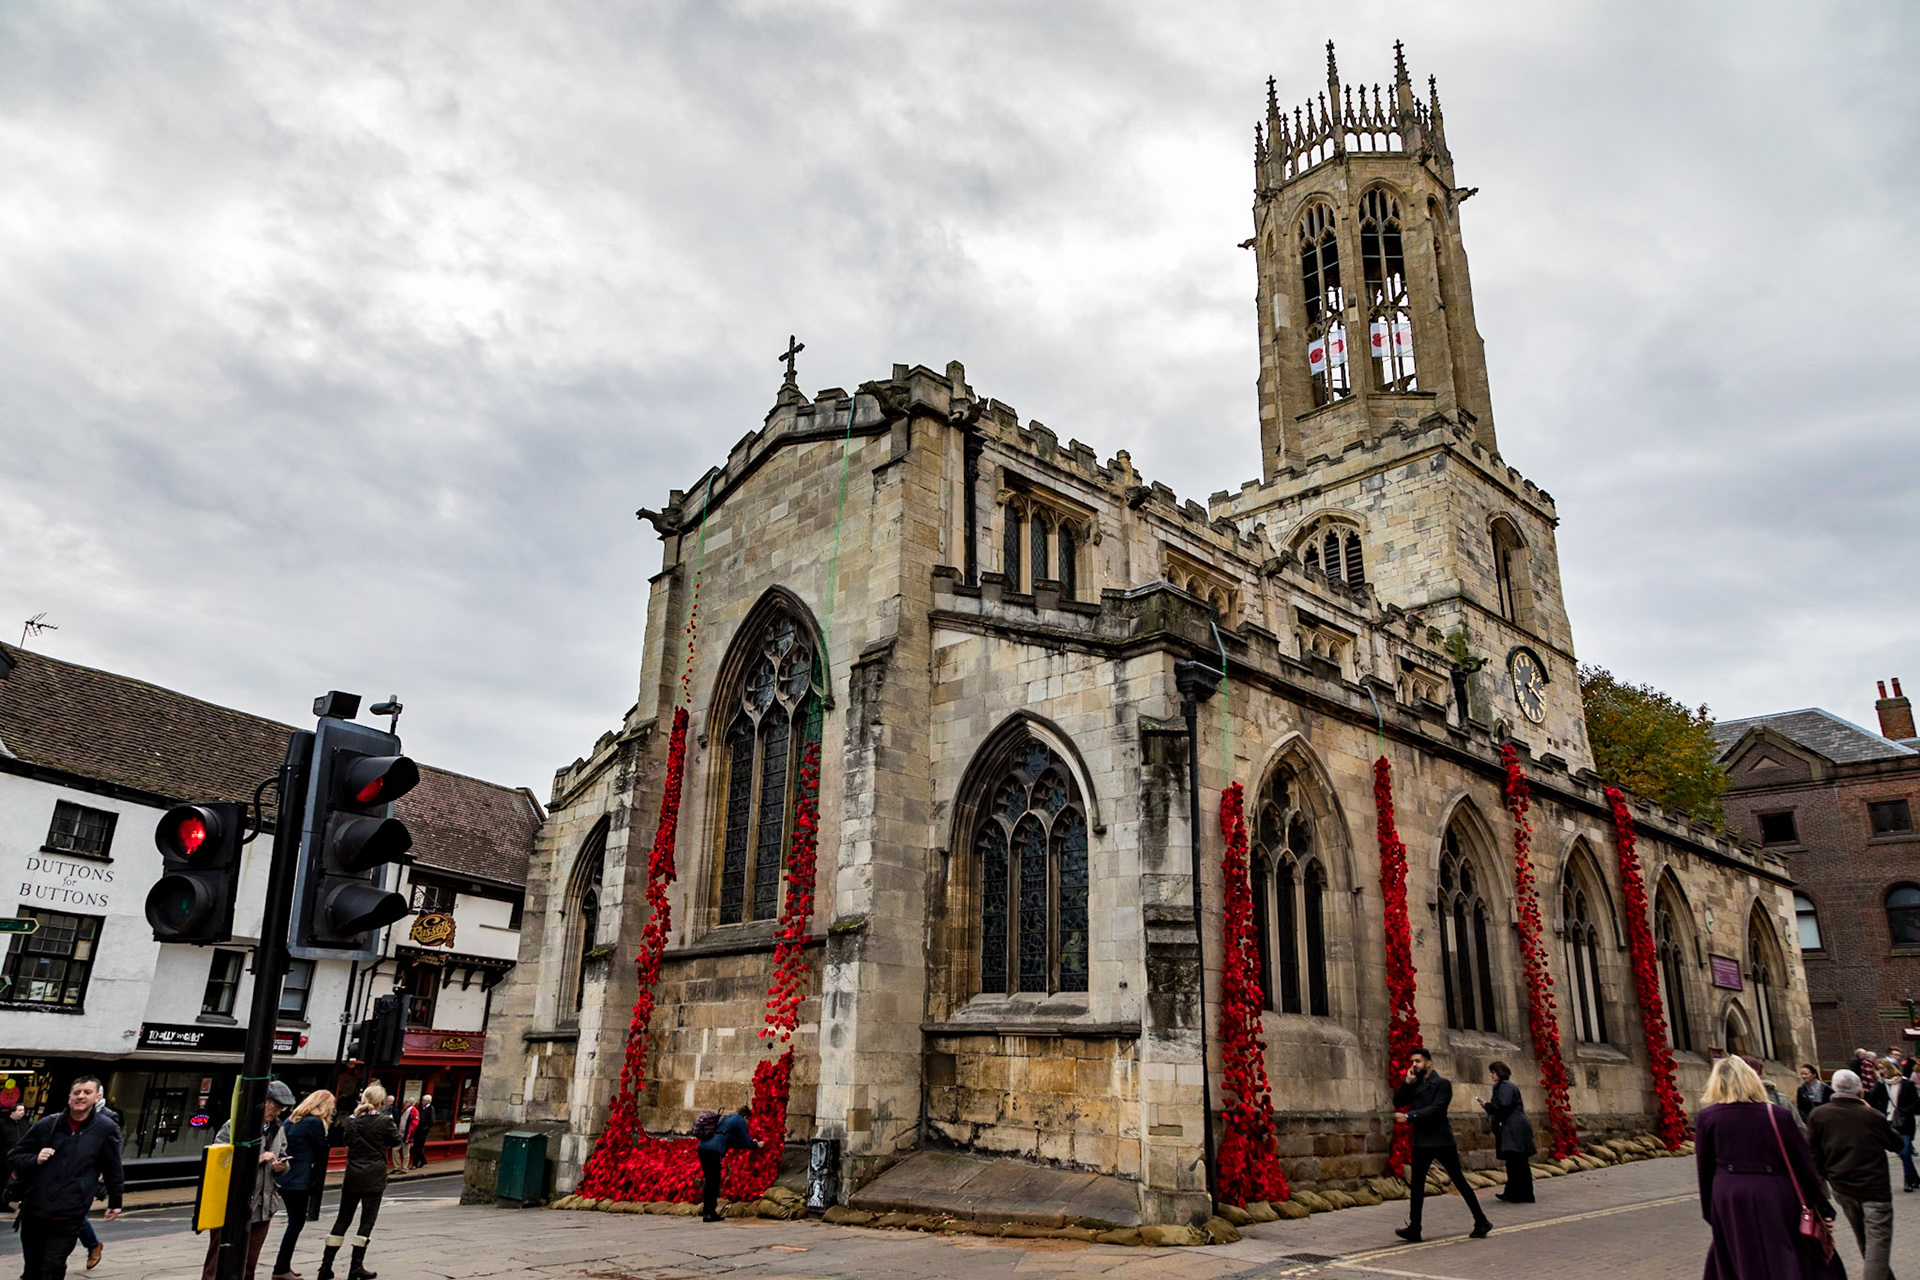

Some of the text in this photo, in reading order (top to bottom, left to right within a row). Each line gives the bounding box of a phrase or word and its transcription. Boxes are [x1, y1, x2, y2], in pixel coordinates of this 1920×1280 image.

[26, 857, 115, 883] DUTTONS
[62, 876, 77, 887] for
[19, 882, 109, 908] BUTTONS
